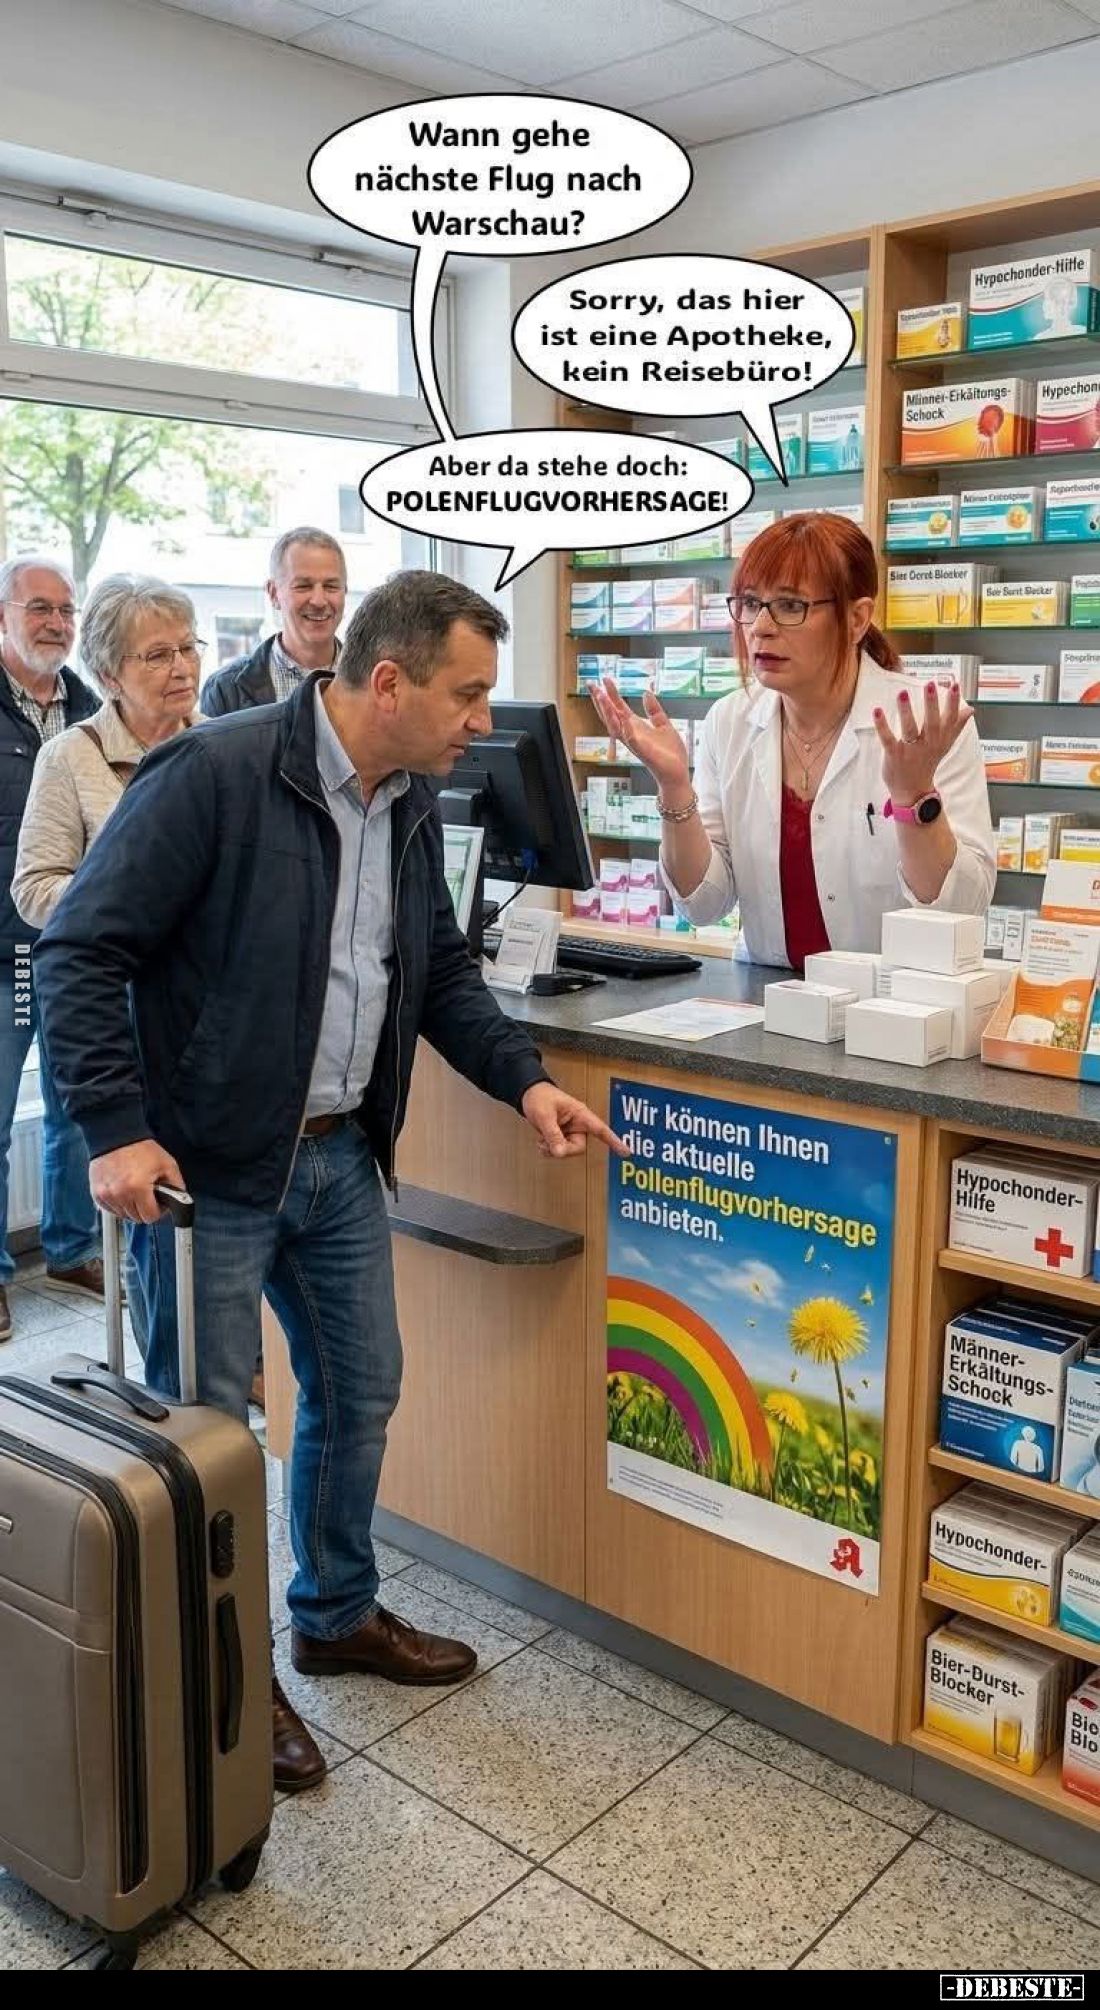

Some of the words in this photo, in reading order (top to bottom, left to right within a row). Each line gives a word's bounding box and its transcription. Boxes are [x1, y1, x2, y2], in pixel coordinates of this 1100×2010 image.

[621, 1095, 658, 1126] Wir
[665, 1104, 750, 1148] können
[758, 1123, 829, 1165] Ihnen
[621, 1129, 656, 1159] die
[662, 1140, 755, 1182] aktuelle
[620, 1160, 878, 1248] Pollenflugvorhersage
[956, 1189, 996, 1212] Hilfe
[957, 1167, 1083, 1208] Hypochonder-
[620, 1198, 724, 1243] anbieten.
[950, 1335, 1025, 1367] Männer-
[948, 1374, 1013, 1407] Schock
[949, 1355, 1054, 1397] Erkältungs-
[935, 1521, 1048, 1571] Hypochonder-
[930, 1667, 995, 1705] Blocker
[931, 1648, 1025, 1698] Bier-Durst-
